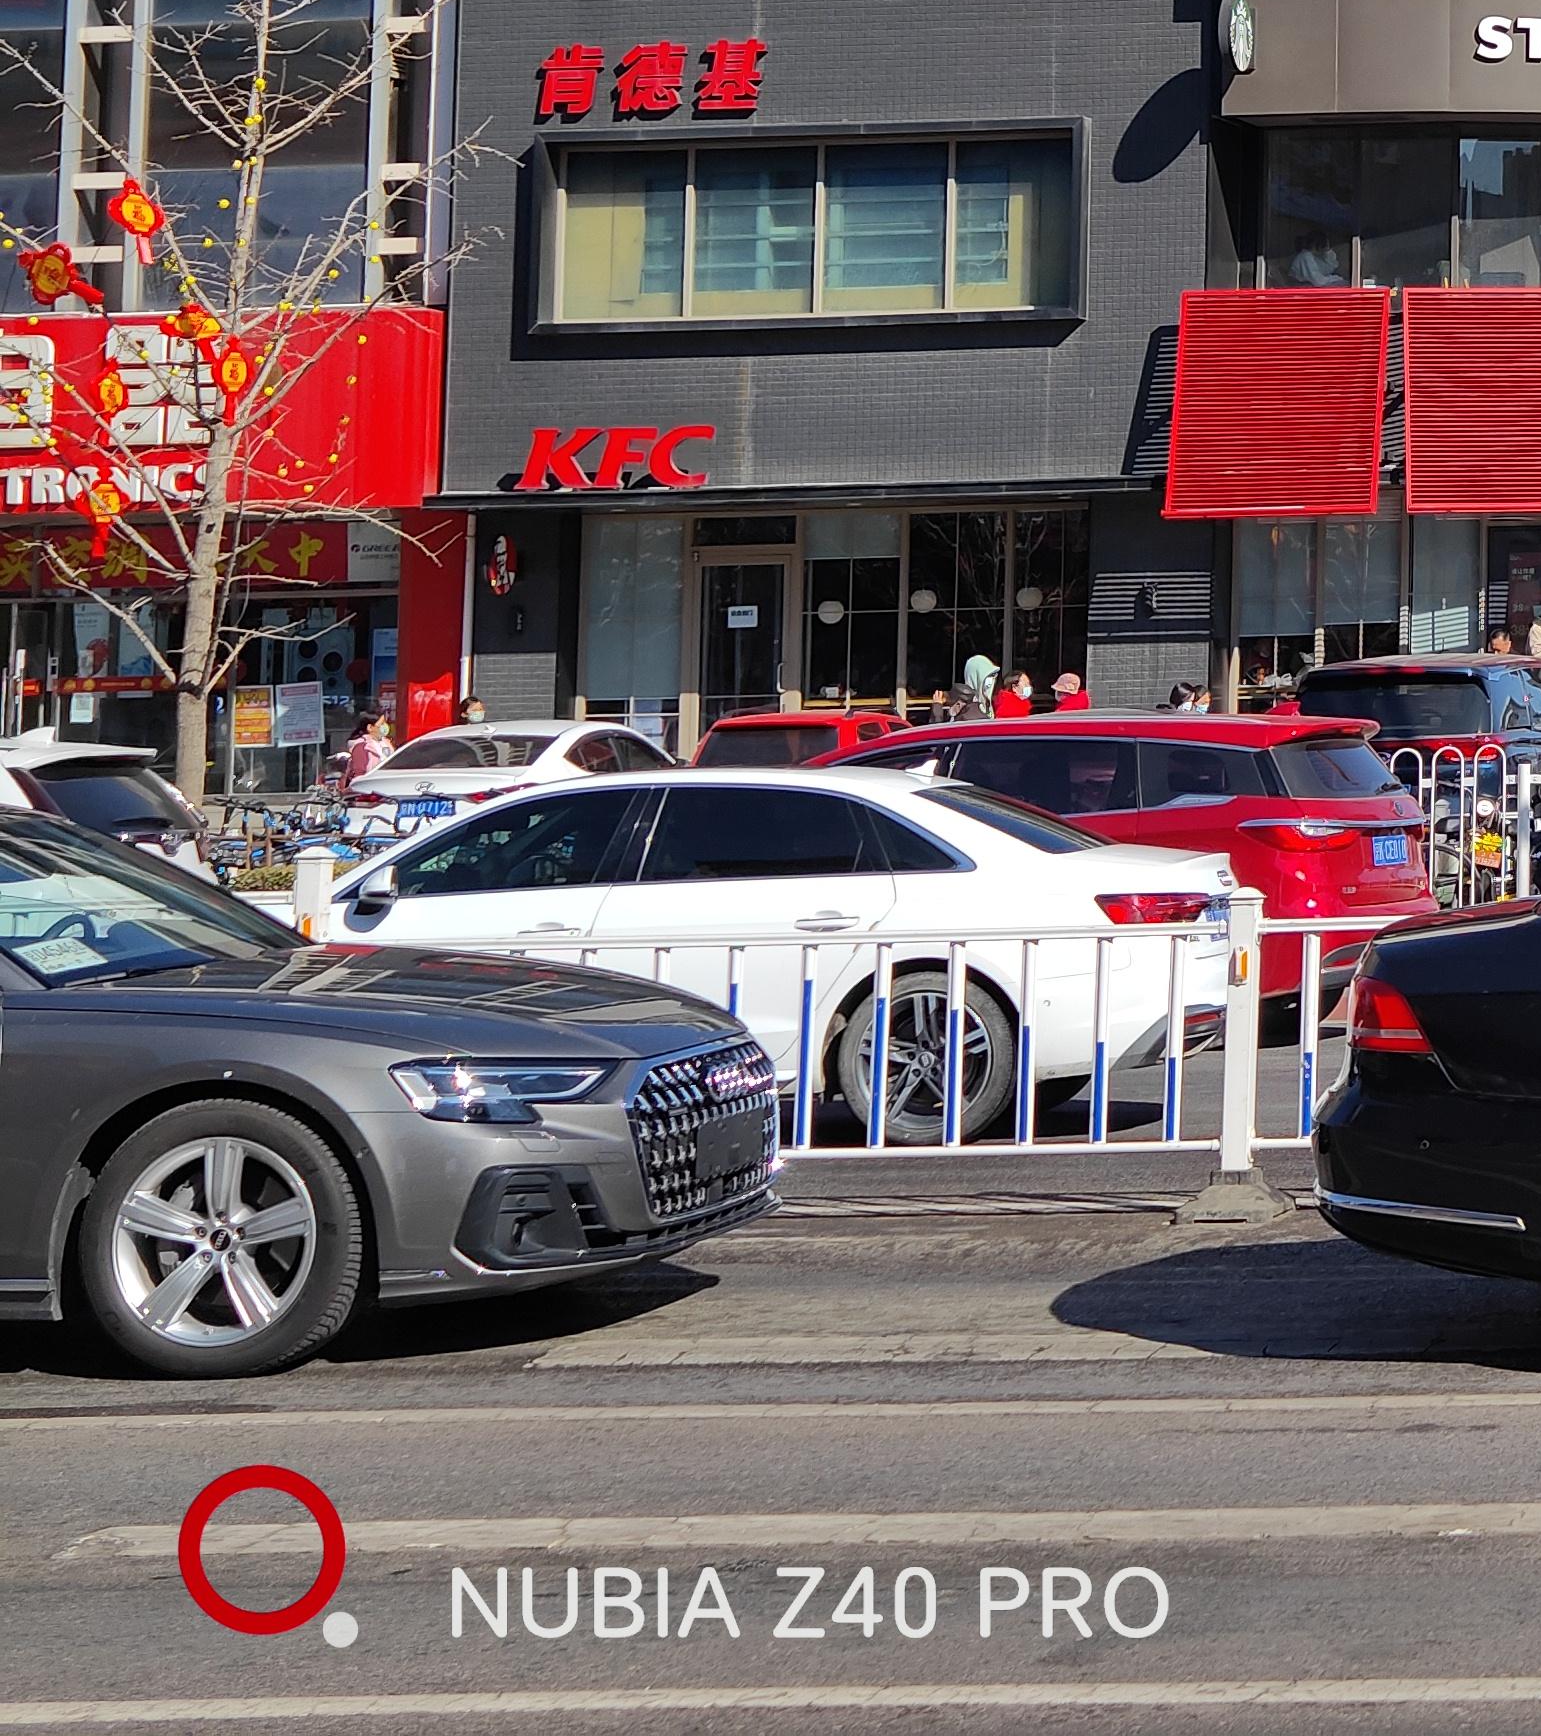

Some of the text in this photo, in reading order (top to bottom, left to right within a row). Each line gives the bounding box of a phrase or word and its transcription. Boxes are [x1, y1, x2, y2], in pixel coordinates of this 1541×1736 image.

[539, 38, 768, 117] 肯德基
[515, 425, 716, 490] KFC
